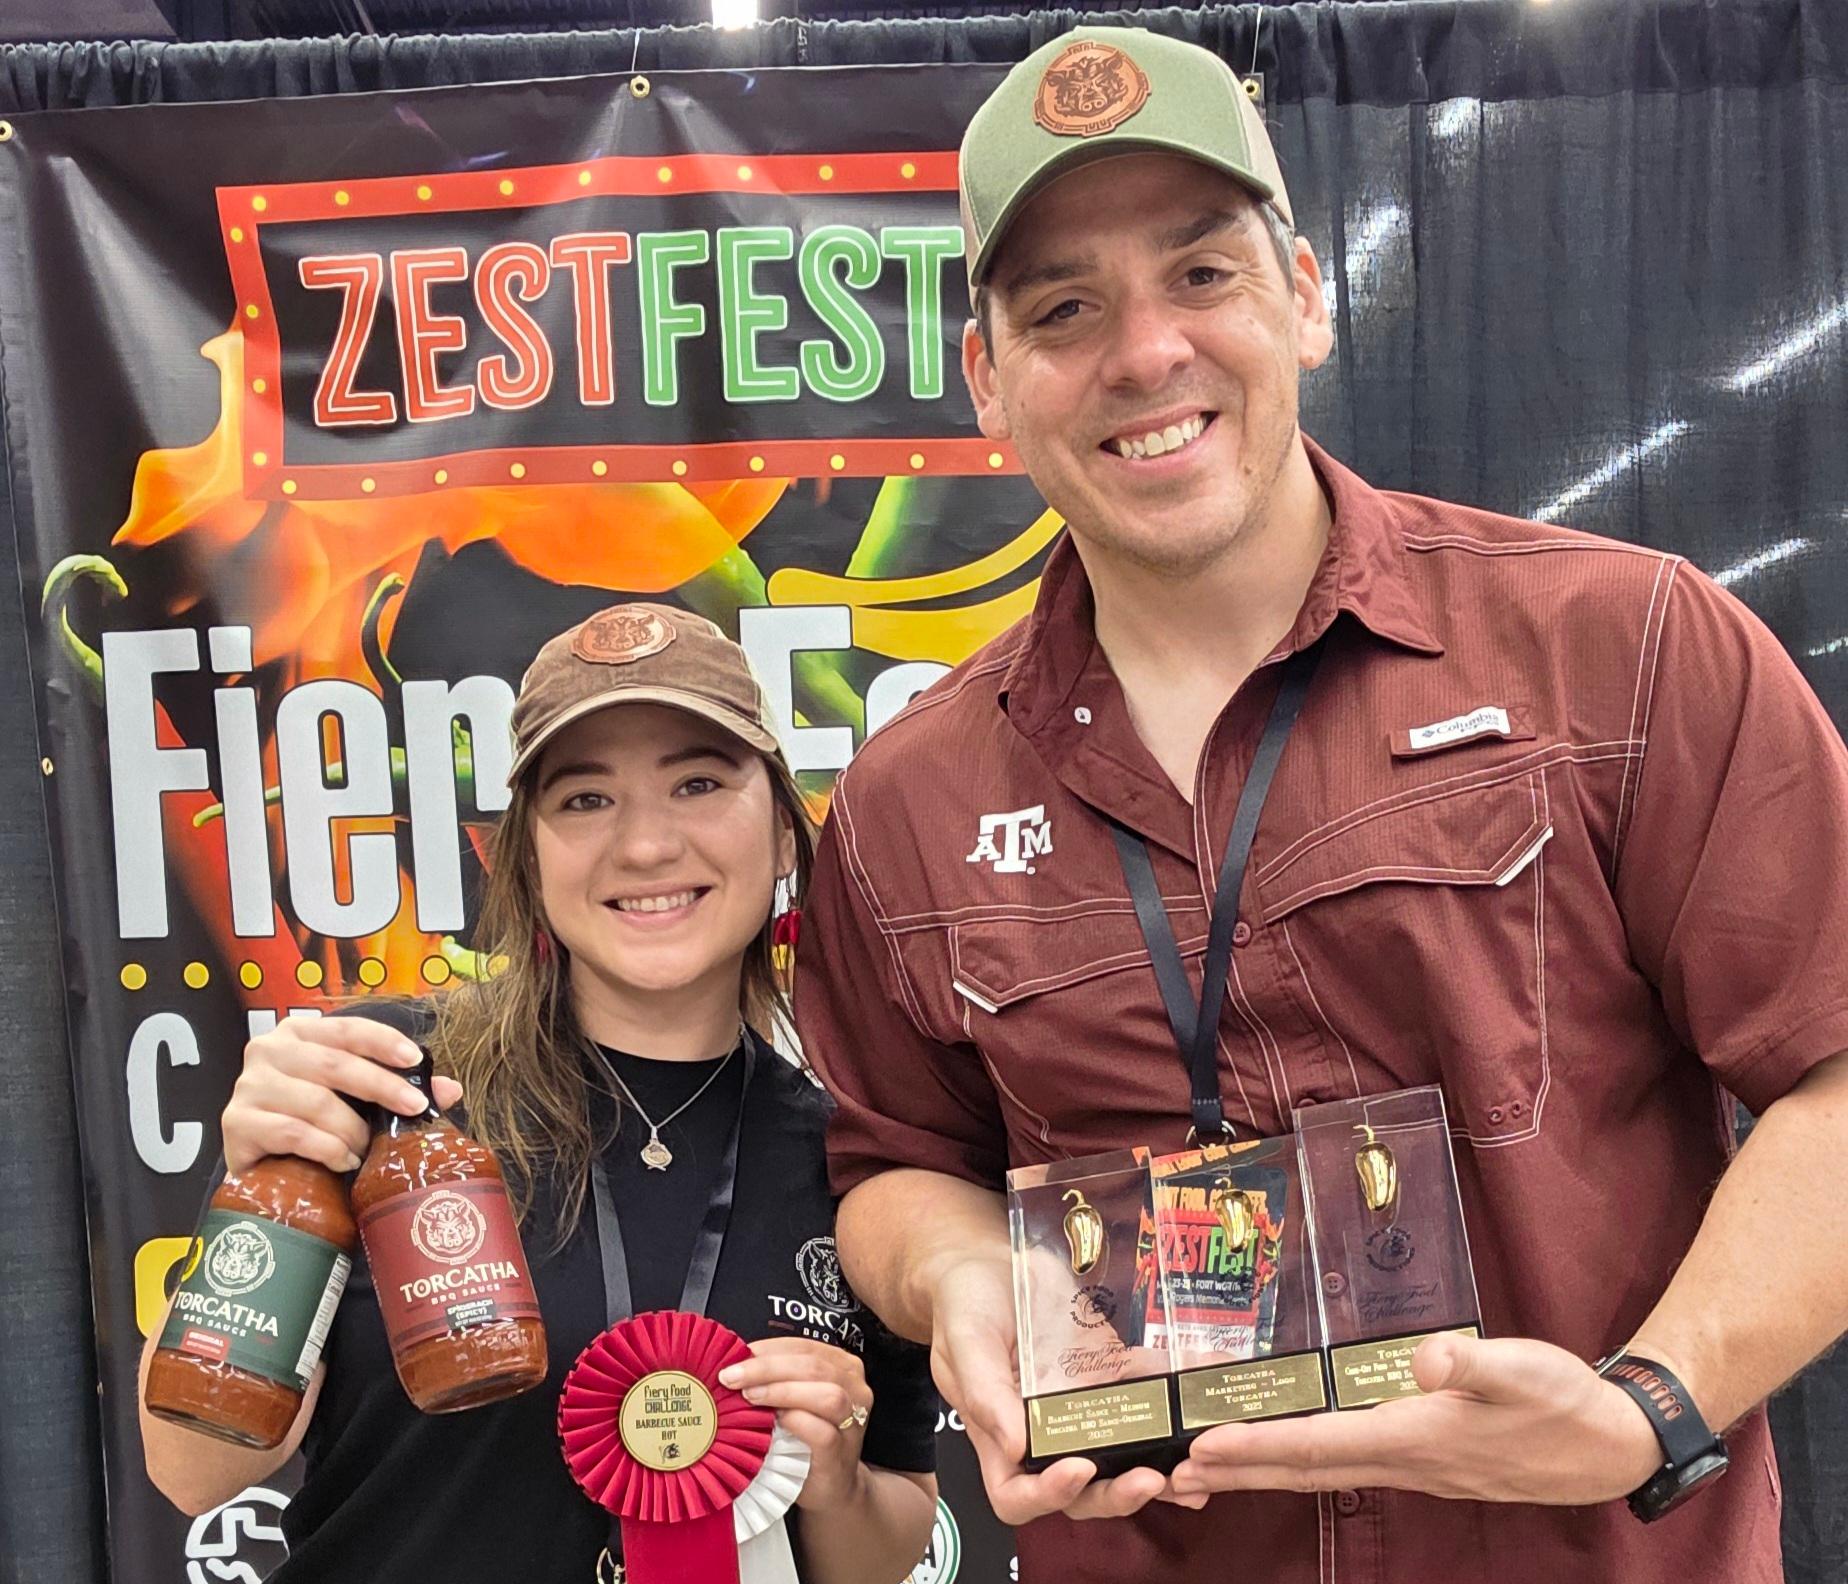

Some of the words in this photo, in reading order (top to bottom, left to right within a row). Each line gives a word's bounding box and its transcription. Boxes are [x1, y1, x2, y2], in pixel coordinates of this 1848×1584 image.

[299, 225, 965, 427] ZESTFEST
[1437, 713, 1499, 735] Columbia
[102, 625, 517, 939] Fier
[400, 1261, 519, 1303] TORCATHA
[431, 1294, 457, 1305] BBQ
[462, 1283, 501, 1297] SAUCE
[175, 1290, 279, 1337] TORCATHA
[767, 1295, 864, 1352] TORCATH
[183, 1314, 203, 1325] BBQ
[207, 1319, 247, 1337] SAUCE
[803, 1327, 830, 1343] BBQ
[1065, 1358, 1132, 1377] Challenge
[635, 1418, 675, 1429] BARBECUE
[677, 1416, 702, 1427] SAUCE
[661, 1430, 677, 1440] HOT
[1087, 1428, 1114, 1441] 2025
